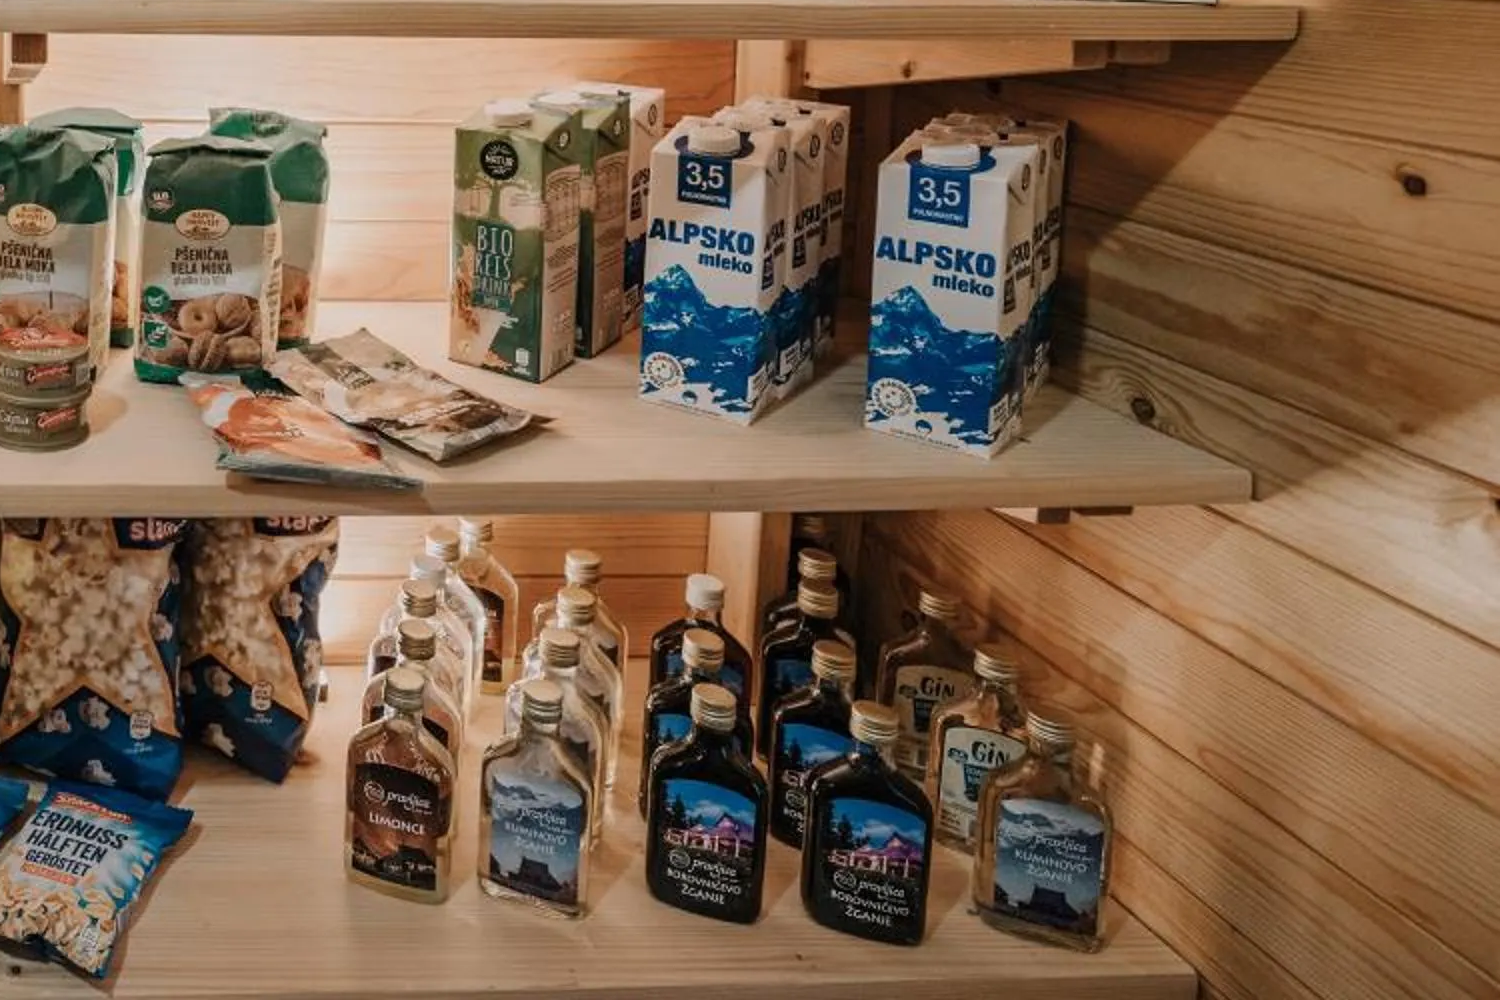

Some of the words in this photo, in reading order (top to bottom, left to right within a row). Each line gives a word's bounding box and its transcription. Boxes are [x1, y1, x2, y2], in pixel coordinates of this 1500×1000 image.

[685, 161, 725, 190] 3,5
[918, 177, 961, 208] 3,5
[477, 225, 513, 258] BIO
[648, 217, 755, 256] ALPSKO
[25, 258, 55, 274] MOKA
[174, 245, 229, 262] PŠENIČNA
[474, 252, 512, 281] REIS
[697, 251, 753, 275] mleko
[875, 234, 996, 279] ALPSKO
[170, 261, 198, 275] BELA
[201, 261, 233, 276] MOKA
[931, 273, 995, 298] mleko
[30, 809, 129, 850] ERDNUSS
